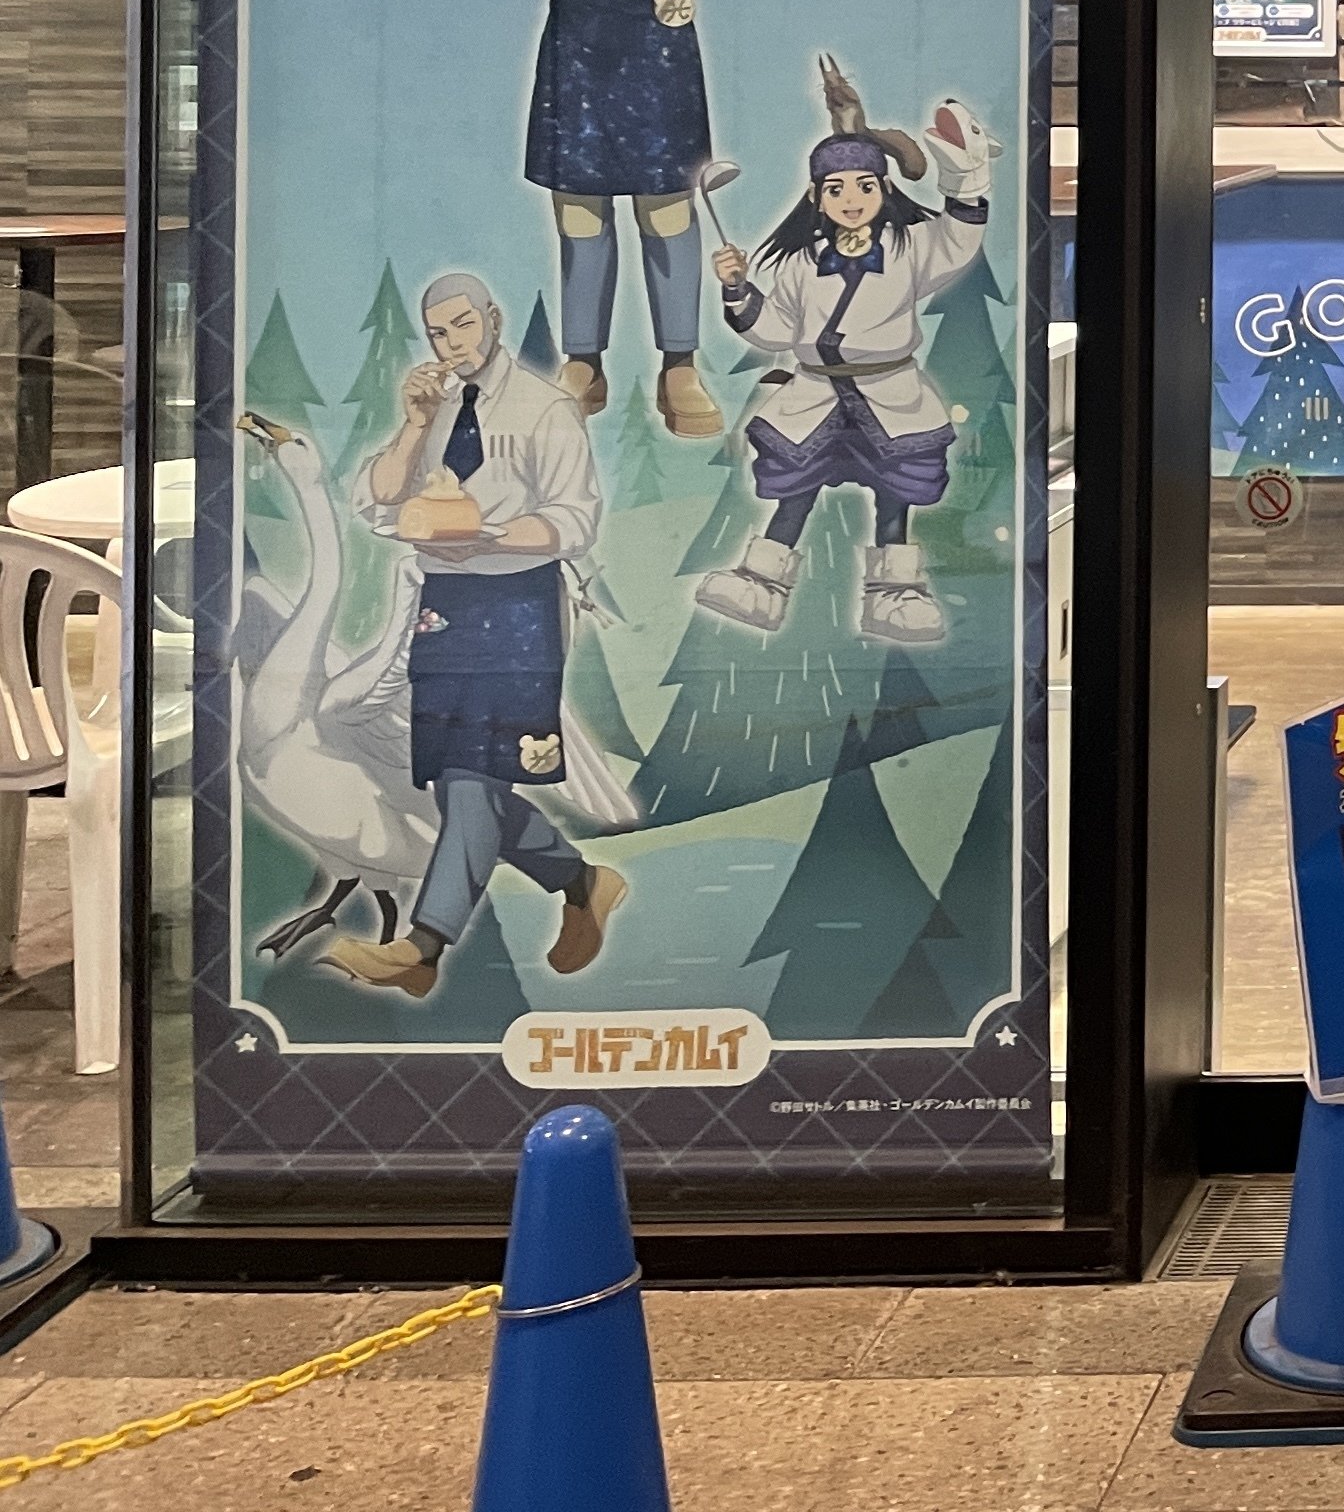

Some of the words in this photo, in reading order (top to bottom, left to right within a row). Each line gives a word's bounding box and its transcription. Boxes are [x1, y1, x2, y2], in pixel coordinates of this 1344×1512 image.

[528, 1024, 749, 1074] ゴールデンカムイ
